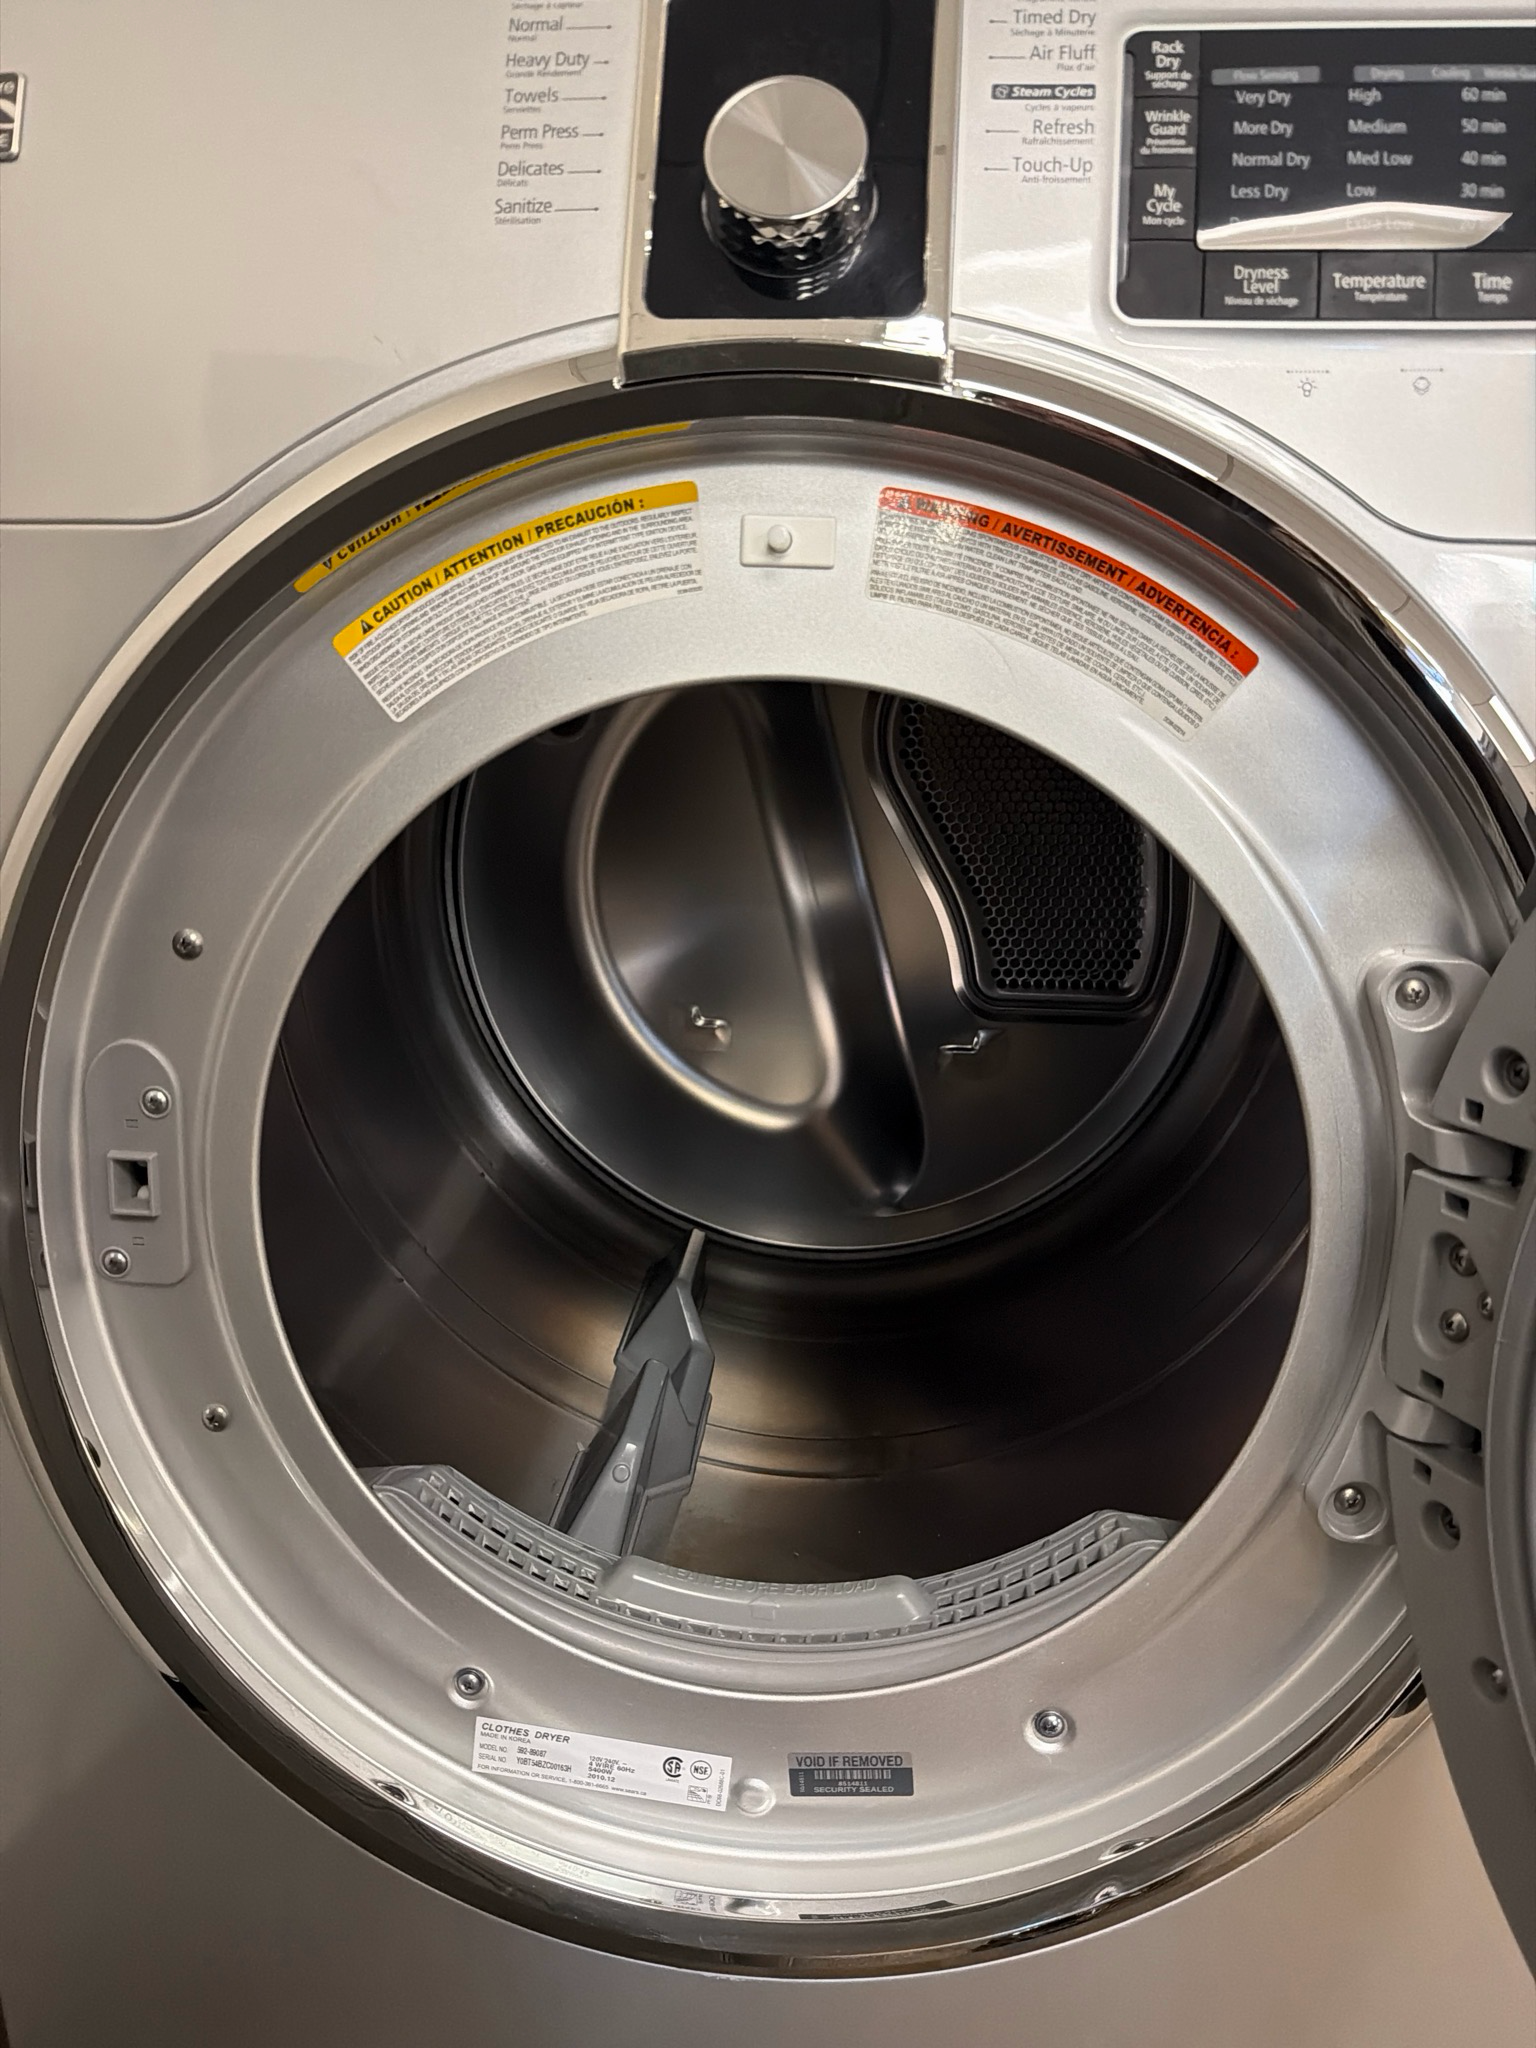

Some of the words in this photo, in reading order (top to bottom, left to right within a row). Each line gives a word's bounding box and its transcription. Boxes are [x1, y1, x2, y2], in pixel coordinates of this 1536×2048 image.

[508, 16, 563, 32] Normal
[1013, 9, 1063, 25] Timed
[1069, 9, 1096, 27] Dry
[1029, 45, 1053, 60] Air
[1059, 44, 1096, 60] Fluff
[1152, 40, 1185, 54] Rack
[505, 53, 550, 70] Heavy
[555, 52, 590, 70] Duty
[1155, 55, 1181, 71] Dry
[1144, 70, 1178, 81] Support
[505, 87, 559, 103] Towels
[1012, 86, 1051, 97] Steam
[1055, 86, 1094, 99] Cycles
[1235, 90, 1265, 107] Very
[1268, 90, 1291, 107] Dry
[1348, 88, 1382, 106] High
[1460, 87, 1479, 102] 60
[1481, 88, 1507, 102] min
[1025, 104, 1051, 112] Cycles
[1062, 104, 1094, 112] vapeurs
[1145, 110, 1192, 123] Wrinkle
[501, 124, 538, 140] Perm
[542, 124, 580, 139] Press
[1033, 118, 1095, 135] Refresh
[1150, 123, 1186, 137] Guard
[1233, 121, 1268, 136] More
[1270, 121, 1293, 138] Dry
[1348, 119, 1408, 135] Medium
[1461, 118, 1479, 133] 50
[1480, 118, 1507, 134] min
[1013, 156, 1093, 176] Touch-Up
[1232, 152, 1283, 167] Normal
[1286, 152, 1311, 170] Dry
[1347, 150, 1380, 166] Med
[1382, 151, 1413, 166] Low
[1460, 150, 1479, 165] 40
[1480, 151, 1507, 166] min
[498, 161, 564, 177] Delicates
[1153, 183, 1176, 200] My
[1230, 184, 1260, 199] Less
[1264, 184, 1289, 201] Dry
[1346, 183, 1377, 198] Low
[1460, 183, 1478, 198] 30
[1478, 184, 1506, 198] min
[495, 198, 553, 215] Sanitize
[1146, 199, 1183, 215] Cycle
[1234, 265, 1289, 283] Dryness
[1333, 272, 1427, 292] Temperature
[1473, 272, 1513, 291] Time
[1243, 280, 1280, 295] Level
[370, 576, 434, 624] CAUTION
[440, 532, 524, 581] ATTENTION
[533, 495, 635, 539] PRECAUCIÓN
[1000, 520, 1128, 584] AVERTISSEMENT
[1134, 578, 1233, 653] ADVERTENCIA
[481, 1722, 529, 1737] CLOTHES
[534, 1731, 570, 1743] DRYER
[508, 1735, 531, 1743] KOREA
[478, 1742, 498, 1751] MODEL
[477, 1752, 497, 1761] SERIAL
[796, 1756, 825, 1767] VOID
[829, 1756, 839, 1767] IF
[842, 1755, 903, 1767] REMOVED
[587, 1766, 612, 1774] 5400W
[594, 1761, 614, 1769] WIRE
[616, 1765, 635, 1773] 60Hz
[490, 1766, 529, 1776] INFORMATION
[610, 1786, 646, 1795] www.sears.ca
[587, 1772, 615, 1782] 2010.12
